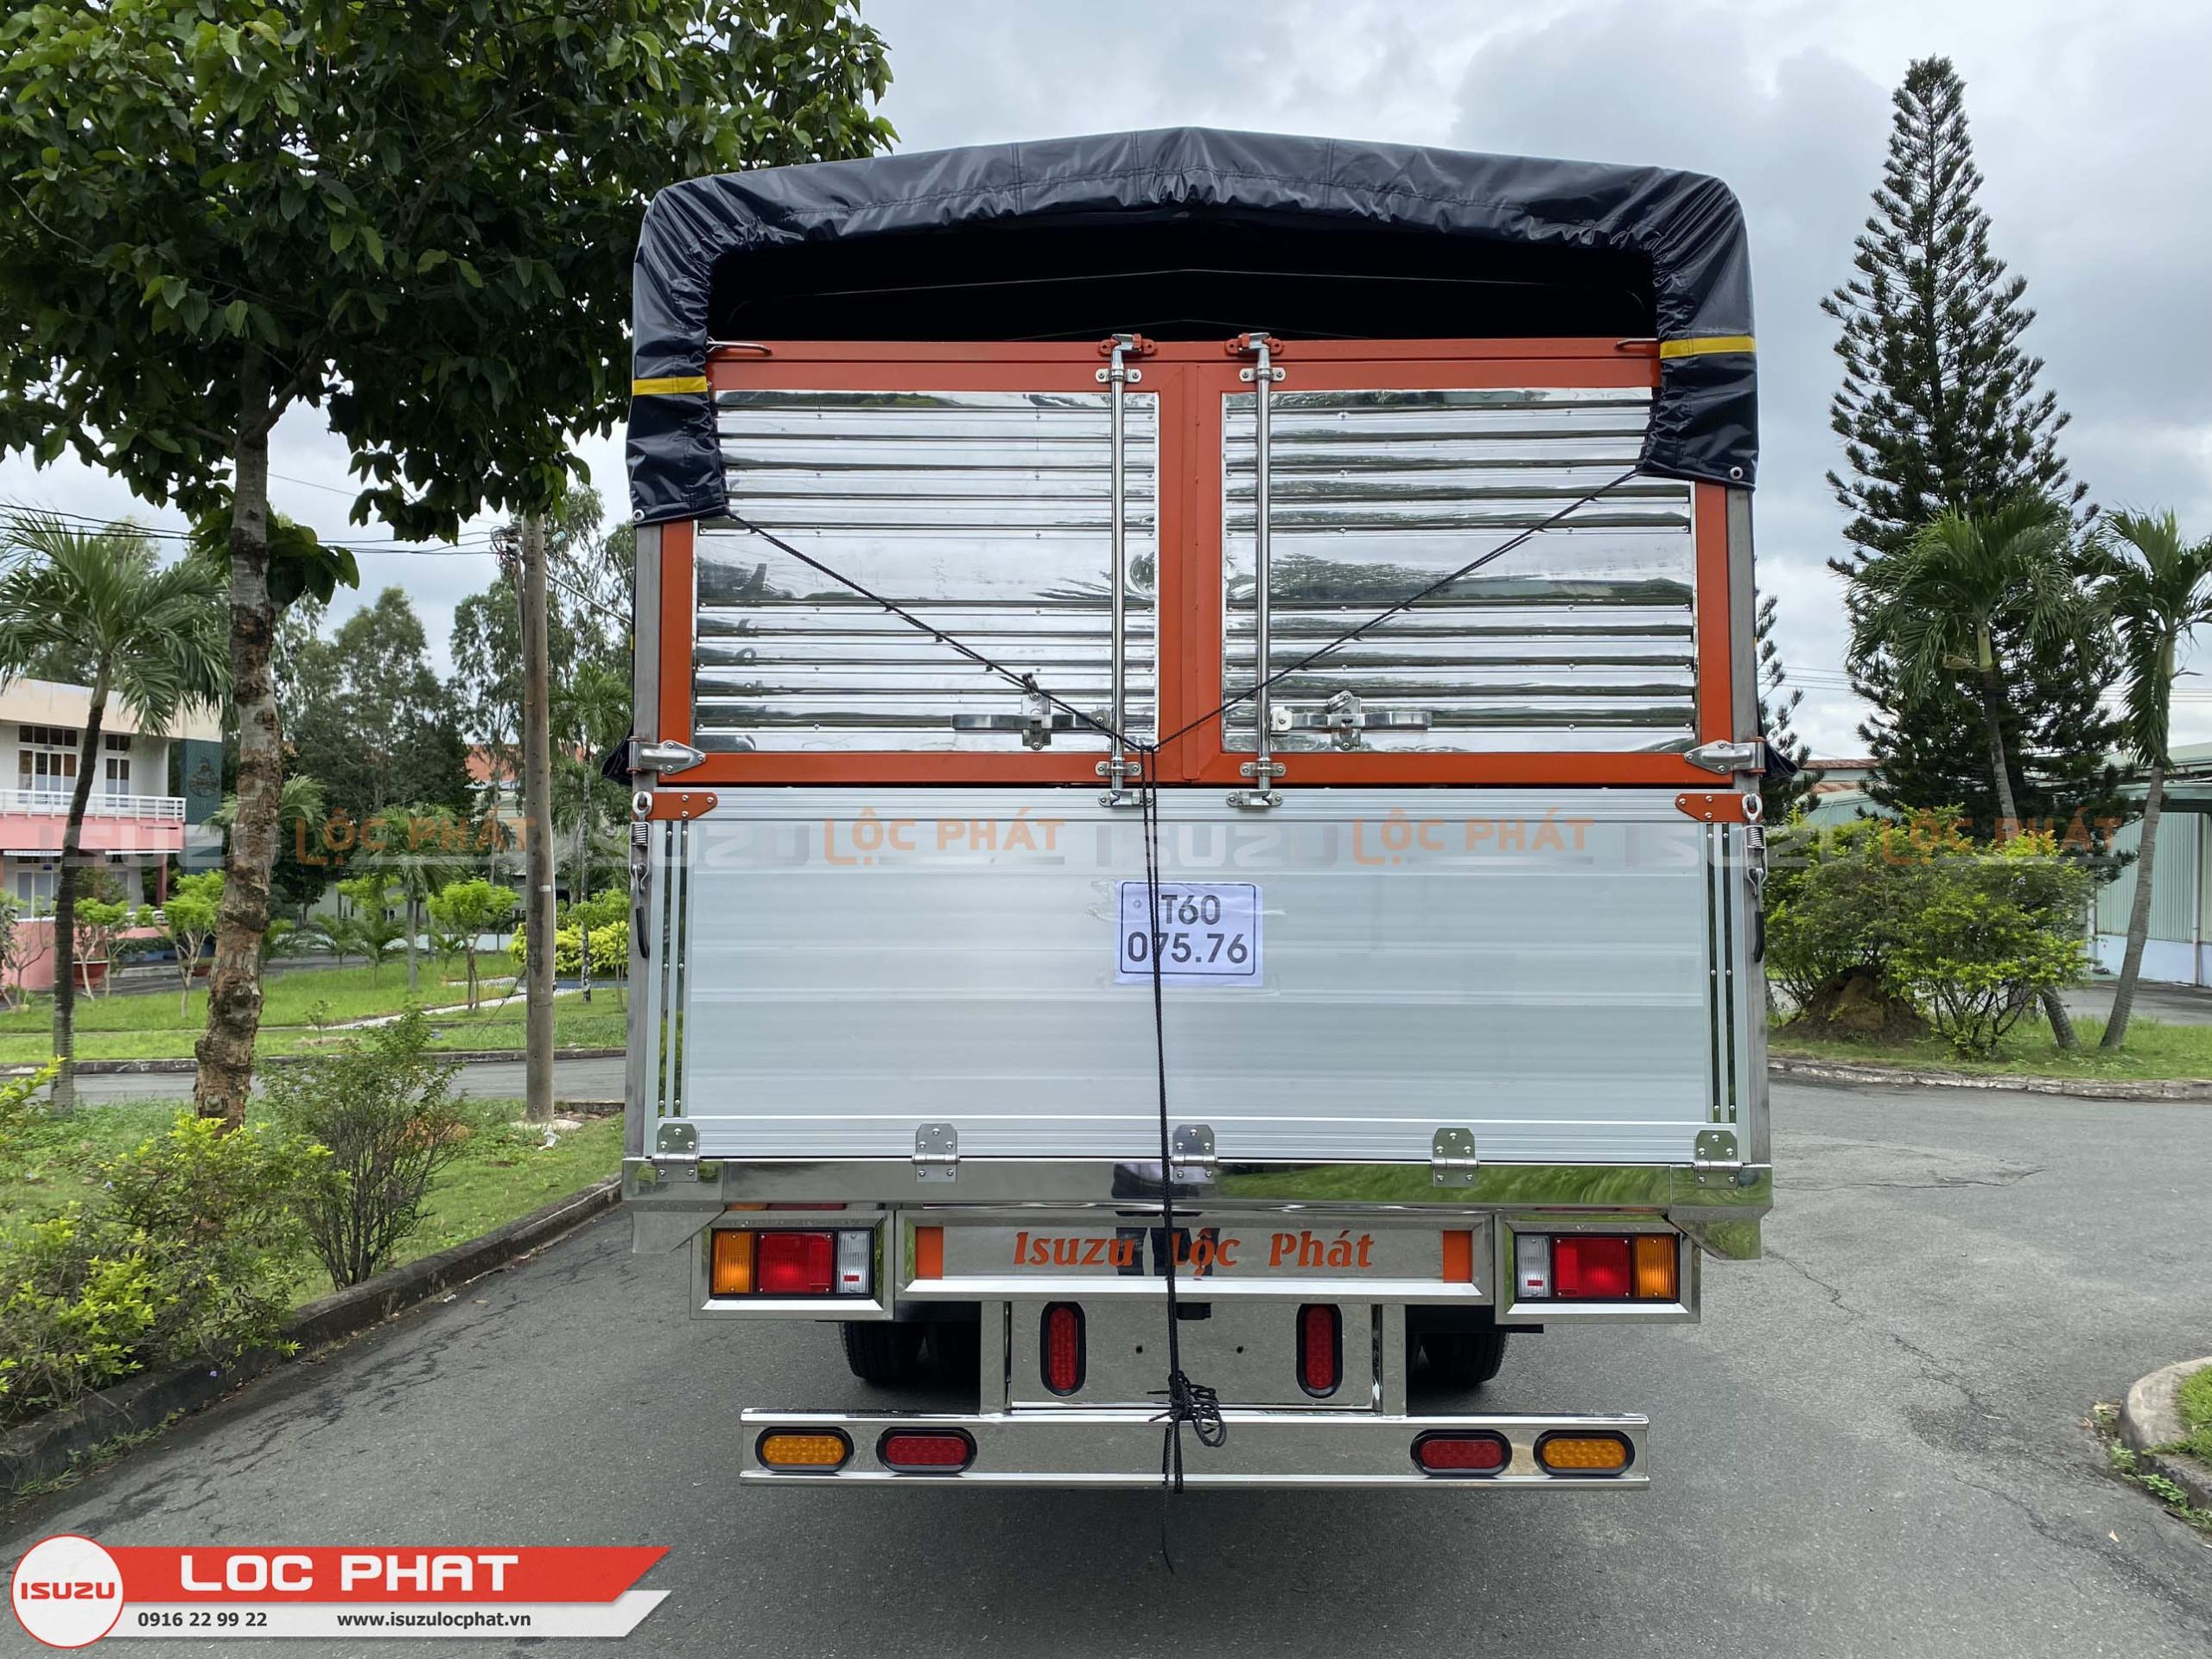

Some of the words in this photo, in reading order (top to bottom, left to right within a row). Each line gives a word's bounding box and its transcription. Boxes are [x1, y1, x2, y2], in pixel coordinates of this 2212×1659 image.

[1161, 894, 1221, 925] T60
[1128, 931, 1248, 963] 075.76
[1013, 1231, 1134, 1266] Isuzu
[1166, 1229, 1241, 1275] Lộc
[1268, 1230, 1375, 1267] Phát
